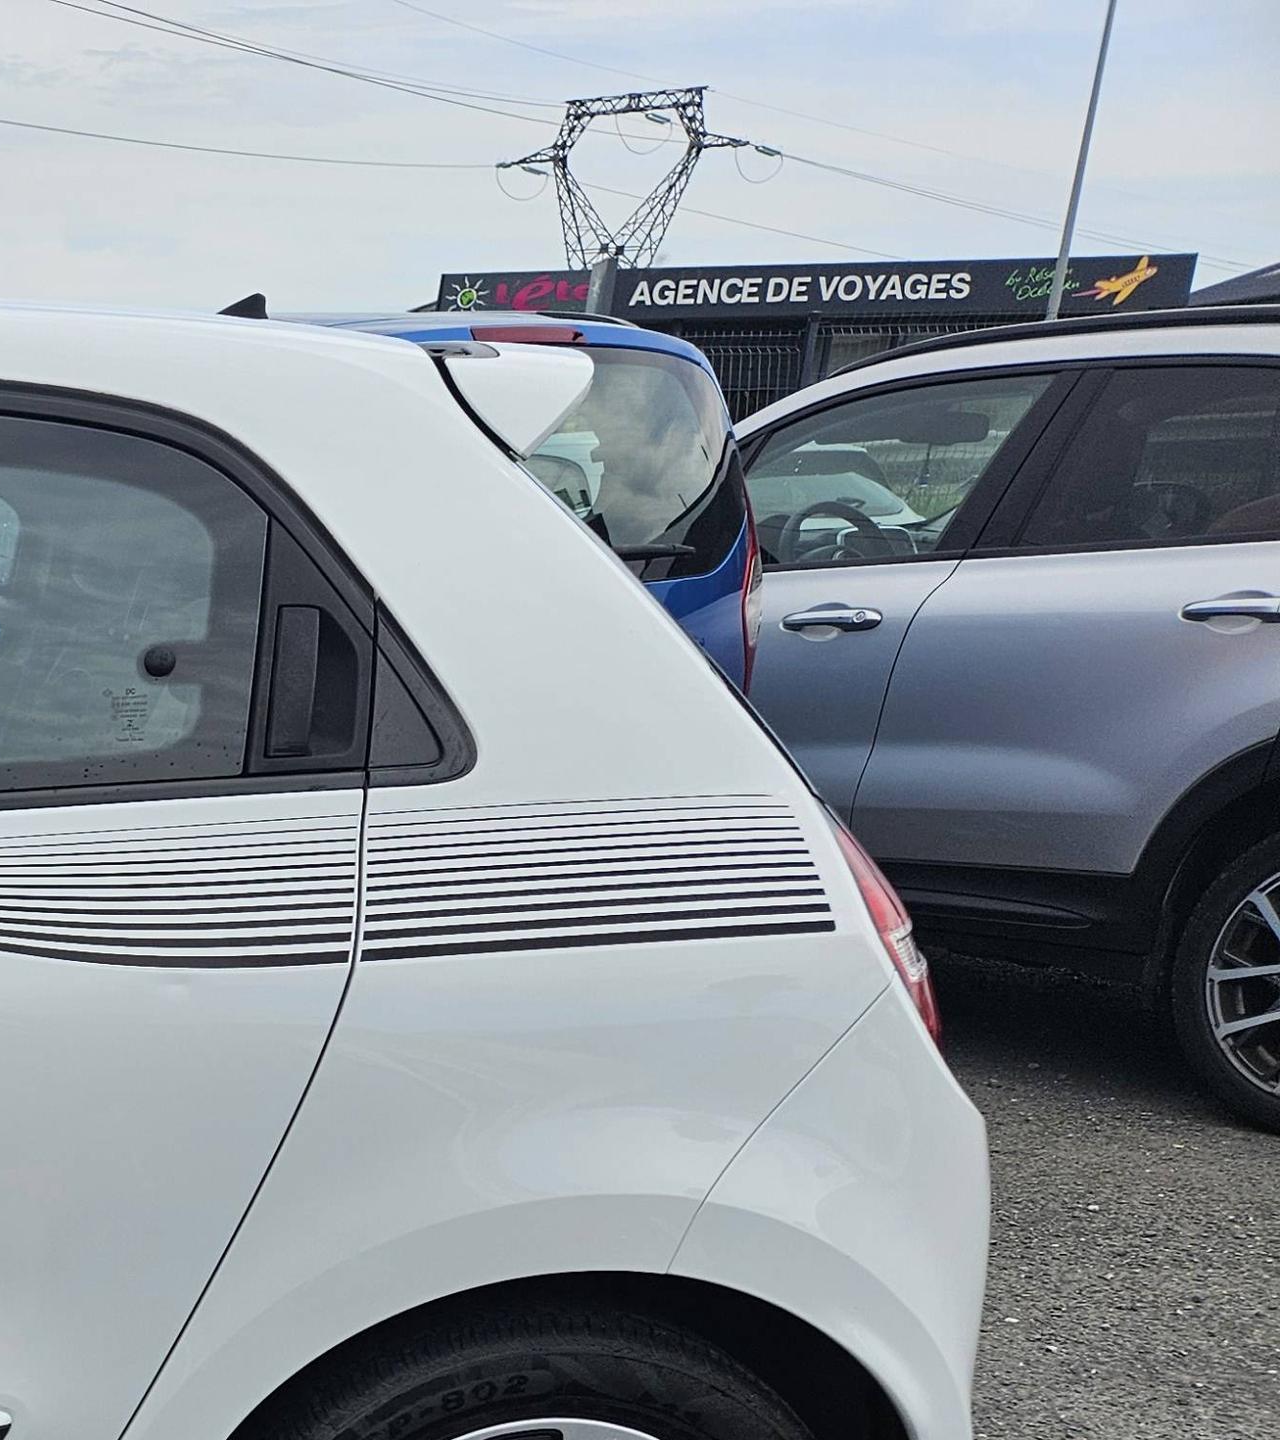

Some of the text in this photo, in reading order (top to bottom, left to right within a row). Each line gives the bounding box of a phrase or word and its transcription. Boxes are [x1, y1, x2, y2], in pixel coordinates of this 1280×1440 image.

[628, 273, 972, 307] AGENCE DE VOYAGES
